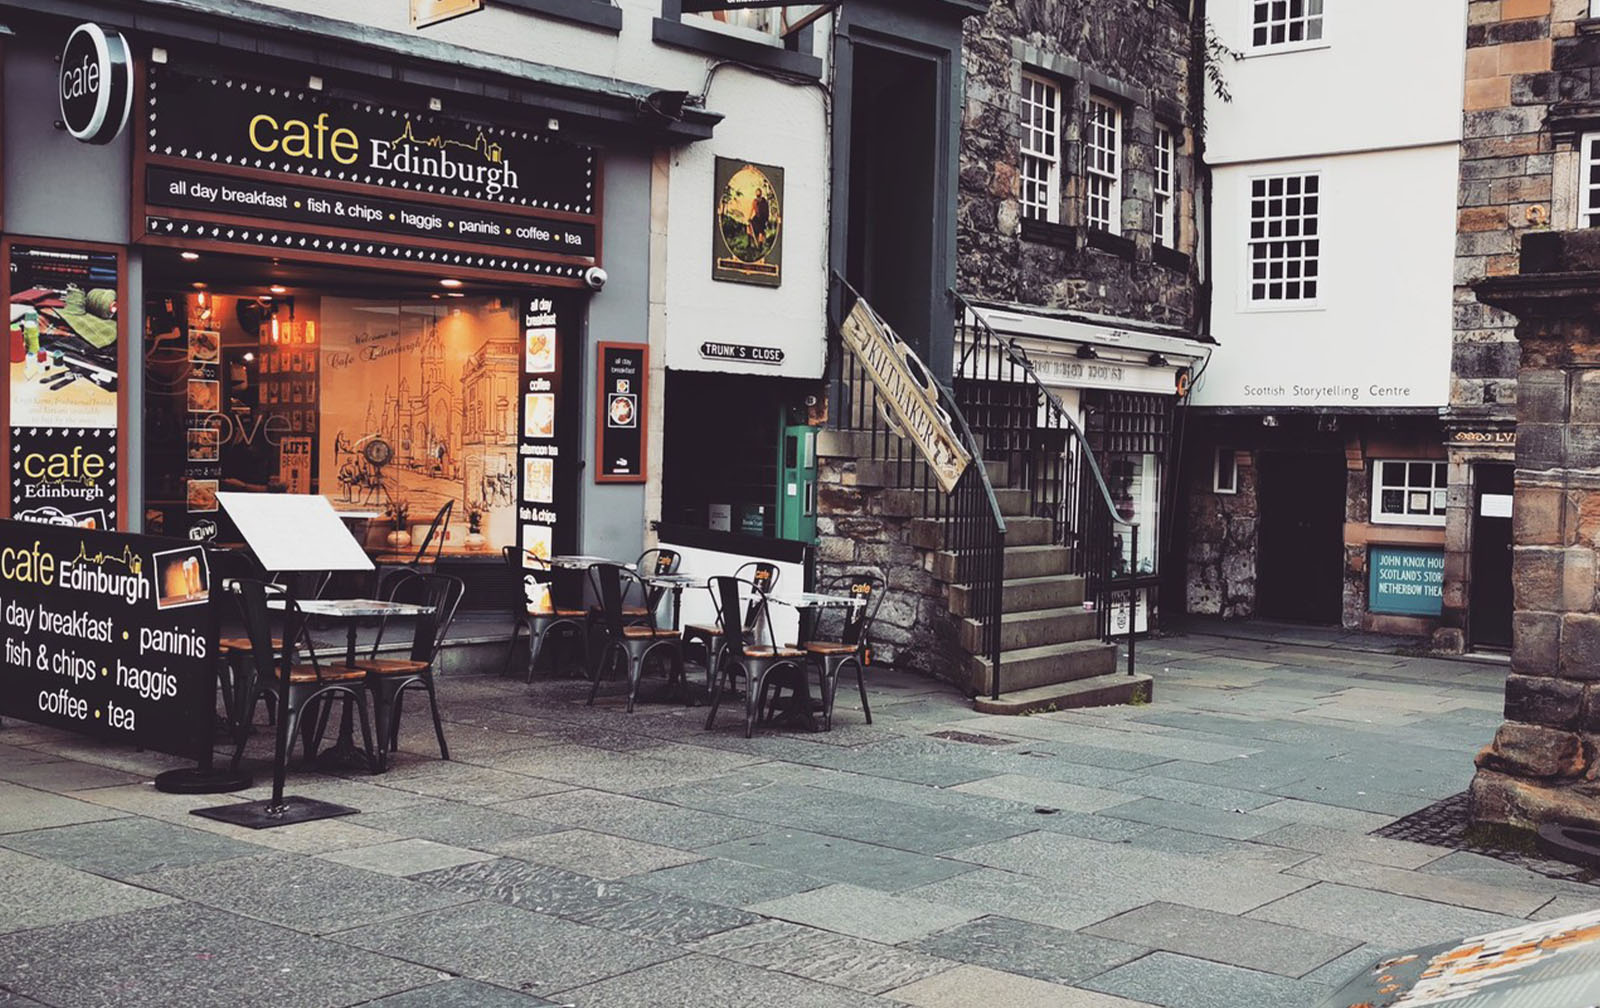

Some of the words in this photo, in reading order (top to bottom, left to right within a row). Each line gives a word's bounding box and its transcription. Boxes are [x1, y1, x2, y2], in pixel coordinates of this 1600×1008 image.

[62, 55, 100, 100] cafe
[248, 112, 360, 166] cafe
[369, 138, 519, 195] Edinburgh
[168, 181, 187, 196] all
[191, 182, 219, 201] day
[221, 185, 288, 210] breakfast
[307, 198, 331, 215] fish
[334, 201, 346, 216] &
[348, 203, 383, 223] chips
[400, 210, 442, 230] haggis
[459, 219, 500, 236] paninis
[516, 225, 552, 241] coffee
[564, 231, 582, 246] tea
[705, 343, 746, 358] TRUNK'S
[752, 348, 780, 361] CLOSE
[1243, 385, 1285, 396] Scottish
[1293, 385, 1360, 400] Storytelling
[1369, 384, 1411, 396] Centre
[24, 446, 105, 479] cafe
[282, 442, 308, 454] LIFE
[24, 483, 104, 501] Edinburgh
[1, 540, 54, 585] cafe
[59, 561, 150, 604] Edinburgh
[1379, 555, 1400, 566] JOHN
[1403, 556, 1425, 568] KNOX
[1379, 569, 1421, 581] SCOTLAND'S
[1379, 583, 1421, 595] NETHERBOW
[6, 601, 34, 634] day
[39, 604, 113, 643] breakfast
[140, 626, 206, 658] paninis
[5, 637, 31, 666] fish
[36, 644, 49, 671] &
[52, 649, 96, 684] chips
[116, 659, 177, 700] haggis
[39, 689, 88, 720] coffee
[107, 700, 135, 731] tea
